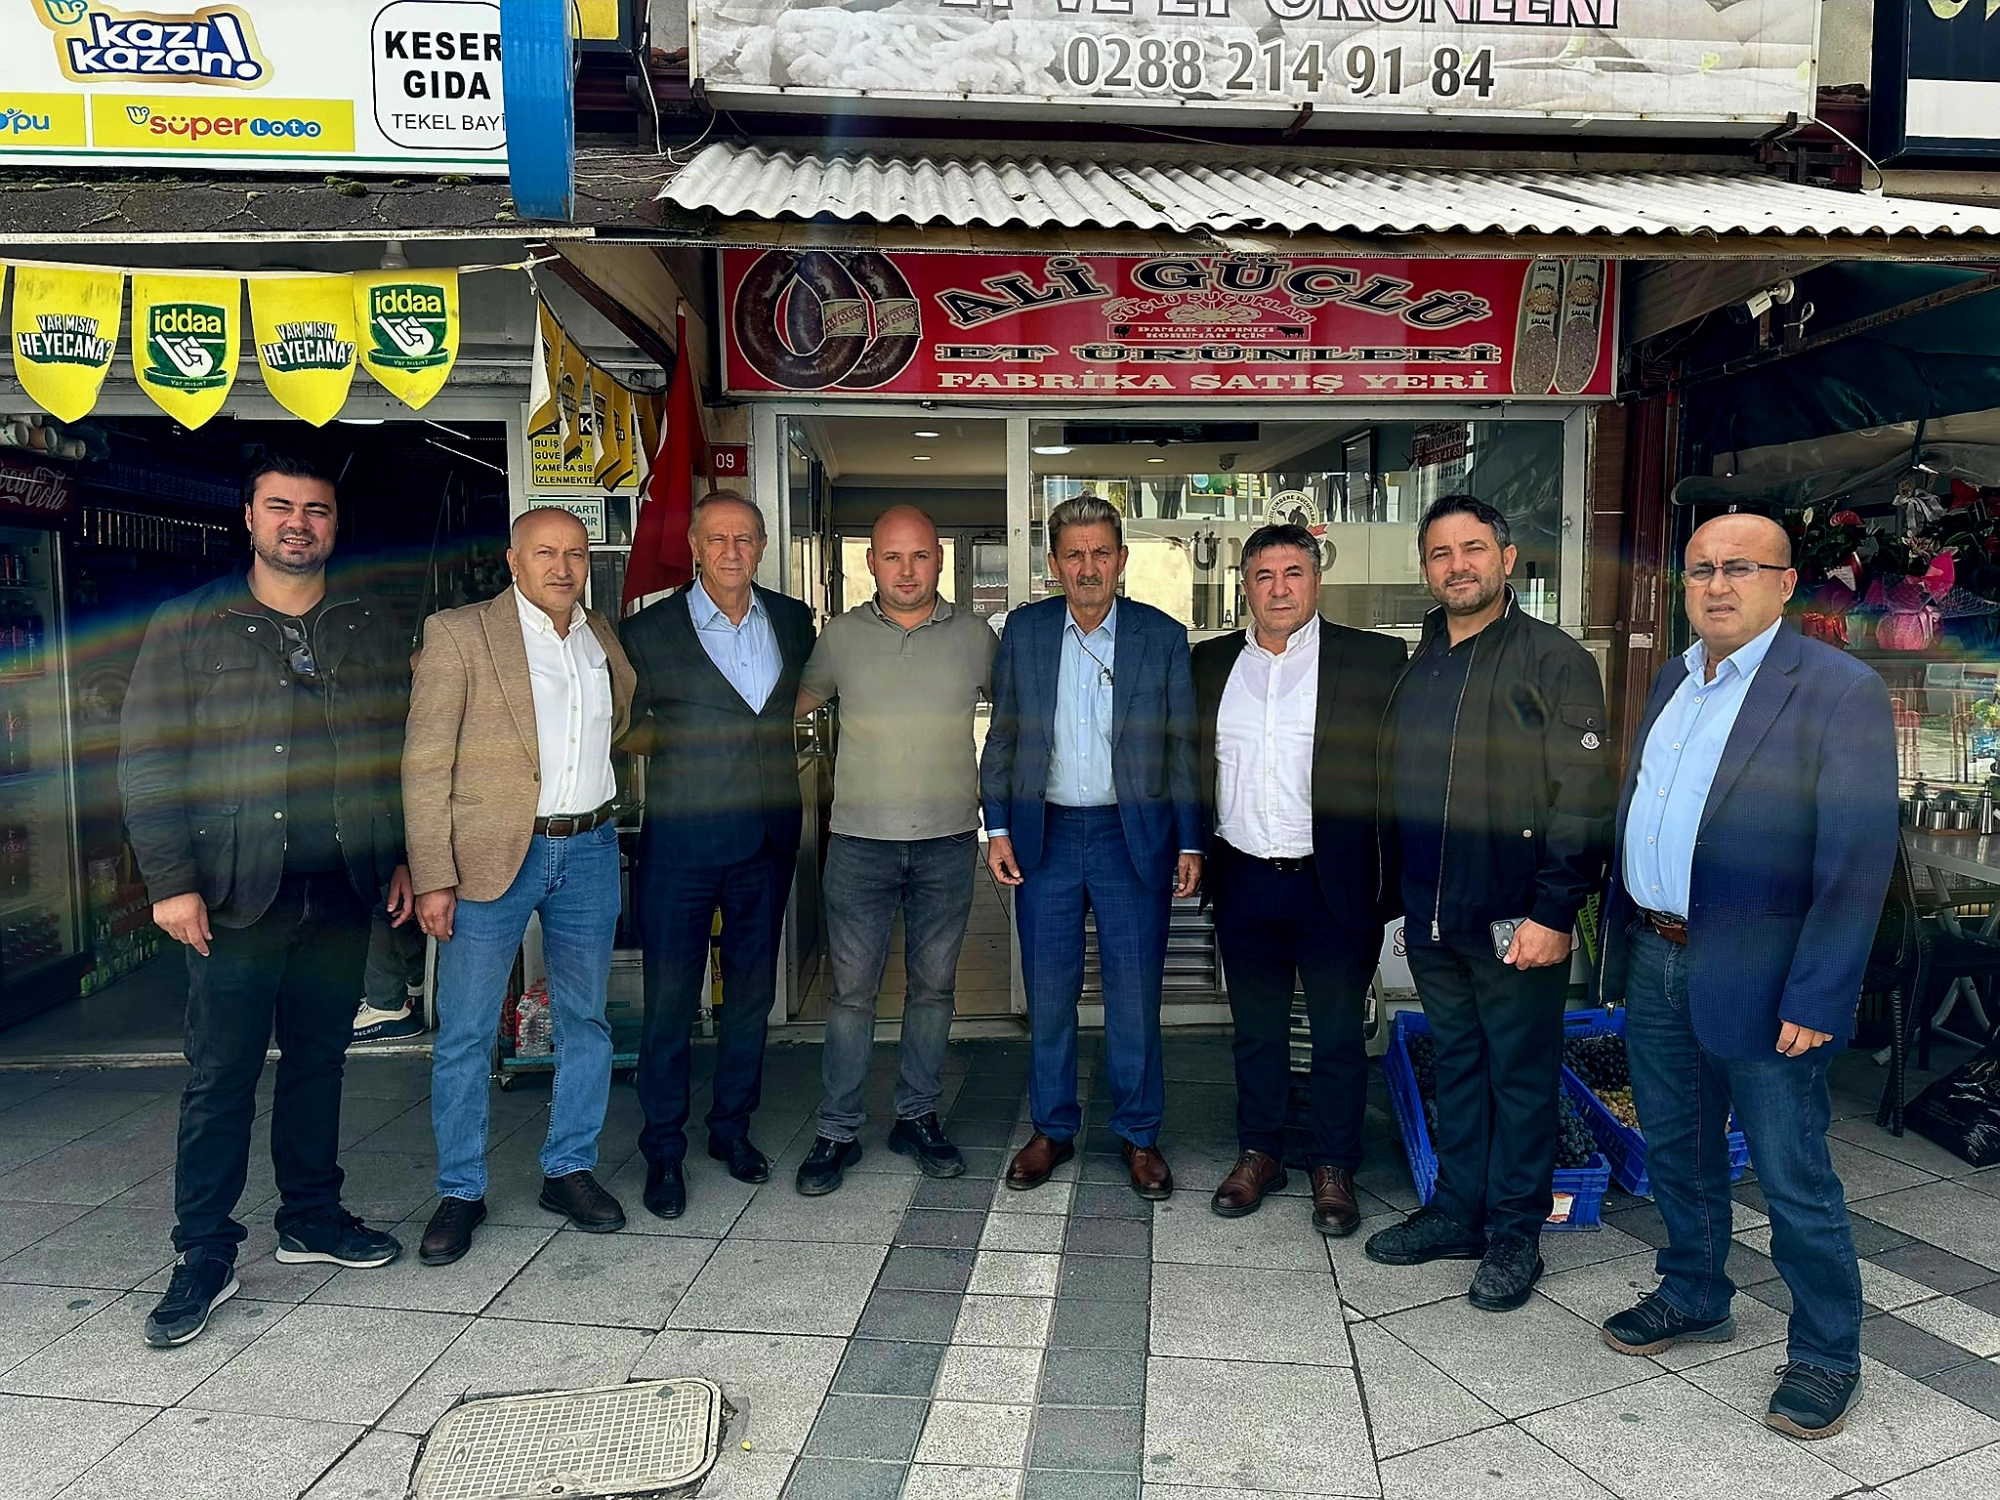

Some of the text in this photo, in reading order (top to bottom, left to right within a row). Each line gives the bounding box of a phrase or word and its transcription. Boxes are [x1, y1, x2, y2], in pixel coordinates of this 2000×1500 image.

[93, 16, 209, 49] kazı
[385, 31, 501, 61] KESER
[1067, 36, 1494, 97] 0288 214 91 84
[404, 70, 491, 99] GIDA
[150, 115, 248, 140] süper
[391, 114, 456, 130] TEKEL
[375, 288, 442, 314] iddaa
[936, 256, 1491, 329] ALİ GÜÇLÜ
[1109, 293, 1181, 323] GÜÇLÜ
[1187, 291, 1317, 323] SUCUKLARI
[37, 313, 98, 335] VAR MISIN
[154, 307, 222, 334] iddaa
[276, 321, 337, 340] VAR MISIN
[18, 331, 115, 362] HEYECANA?
[261, 339, 355, 367] HEYECANA?
[936, 343, 1501, 363] ET ÜRÜNLERİ
[937, 369, 1489, 393] FABRİKA SATIŞ YERİ
[534, 438, 559, 450] BU İŞ
[577, 462, 594, 472] SİS
[716, 453, 734, 469] 09
[0, 465, 67, 510] oca-Cola
[535, 474, 596, 484] İZLENMEKTE
[567, 505, 599, 514] KARTI
[548, 1434, 594, 1451] GAZ
